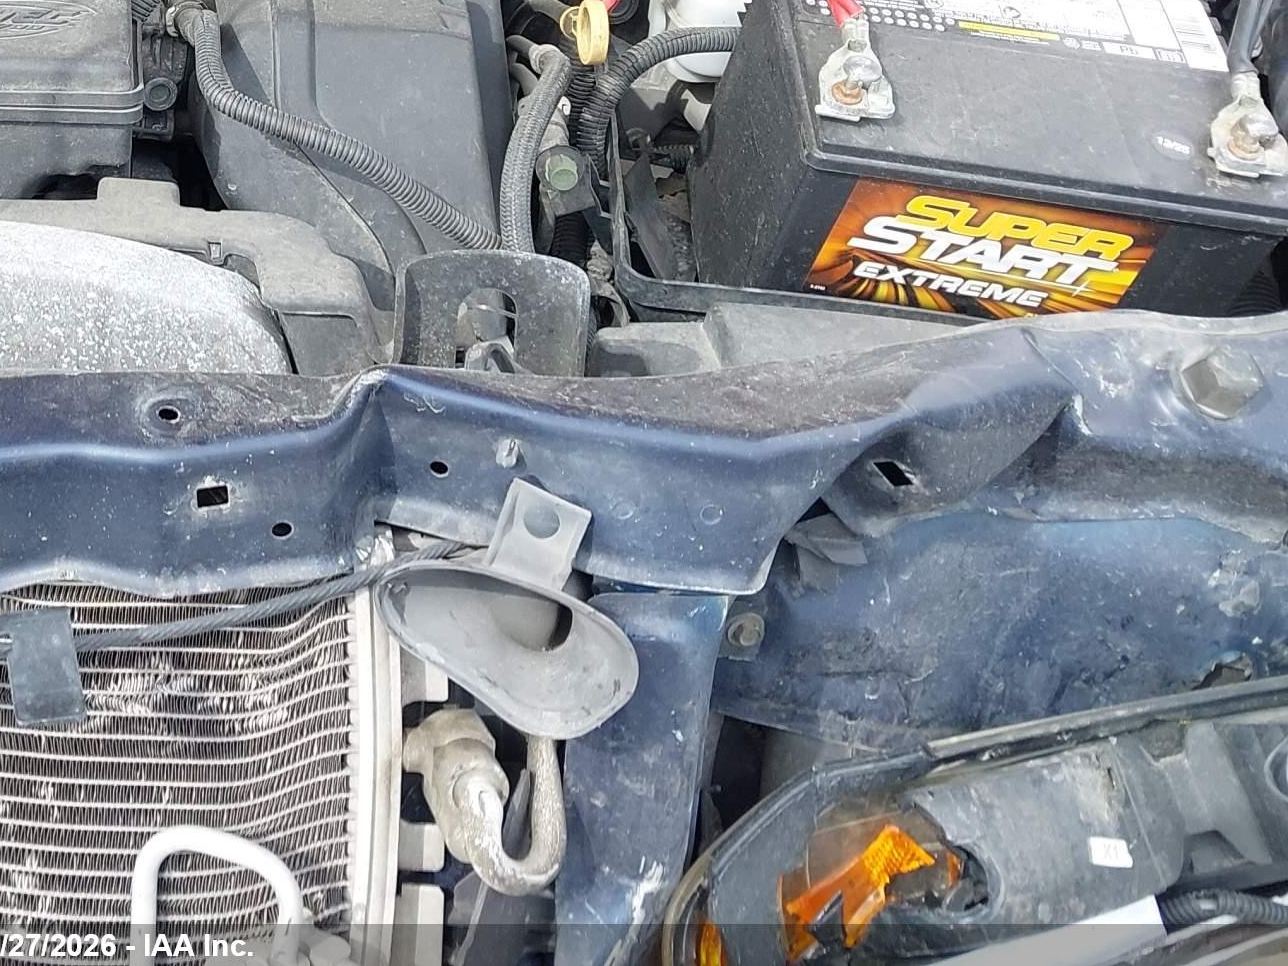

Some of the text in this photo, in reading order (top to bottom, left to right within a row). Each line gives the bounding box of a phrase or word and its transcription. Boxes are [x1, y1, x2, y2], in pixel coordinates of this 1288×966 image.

[847, 216, 1119, 285] START
[895, 195, 1133, 261] SUPER
[853, 261, 1049, 307] EXTREME
